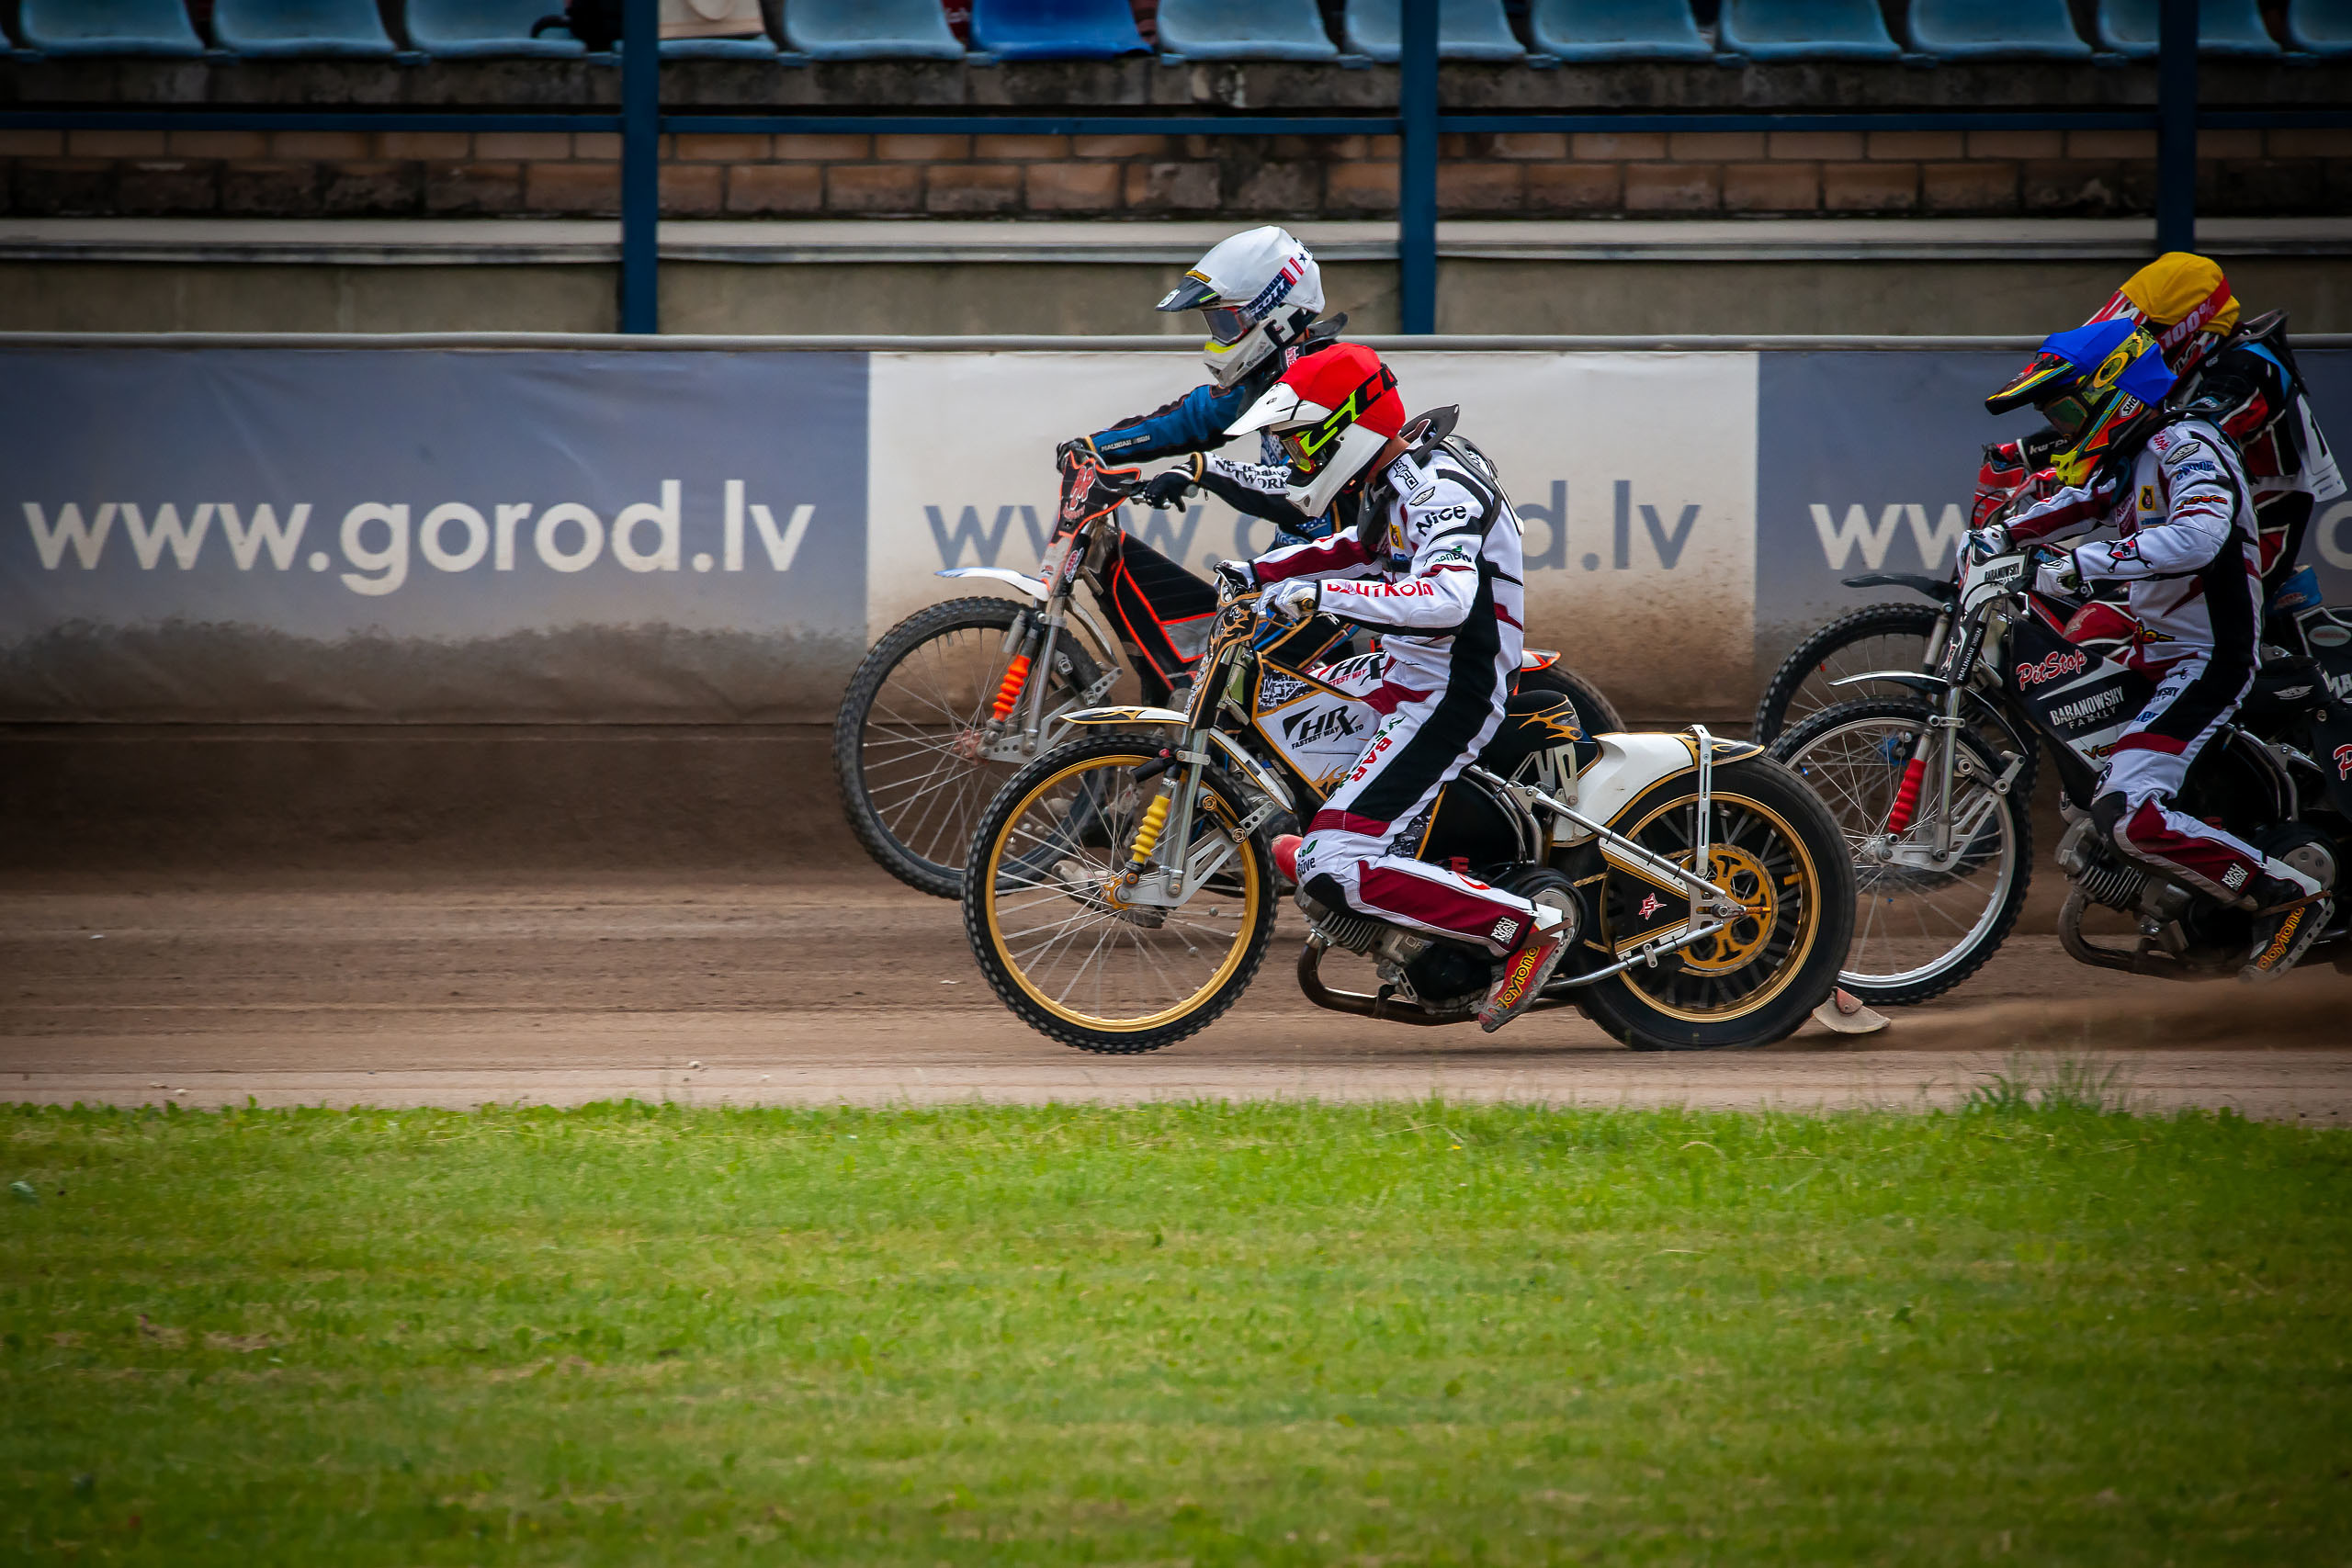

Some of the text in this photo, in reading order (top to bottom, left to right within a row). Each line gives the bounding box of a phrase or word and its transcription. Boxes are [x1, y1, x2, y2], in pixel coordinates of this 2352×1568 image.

[2161, 299, 2215, 350] 100%
[22, 479, 816, 596] www.gorod.lv
[1416, 505, 1467, 537] Nice
[2016, 649, 2087, 691] PitStop
[2050, 686, 2125, 726] BARANOWSKY
[2069, 707, 2116, 729] FAMILY
[1292, 732, 1322, 750] FASTEST
[1323, 726, 1340, 738] WAY
[2256, 906, 2306, 971] daytona
